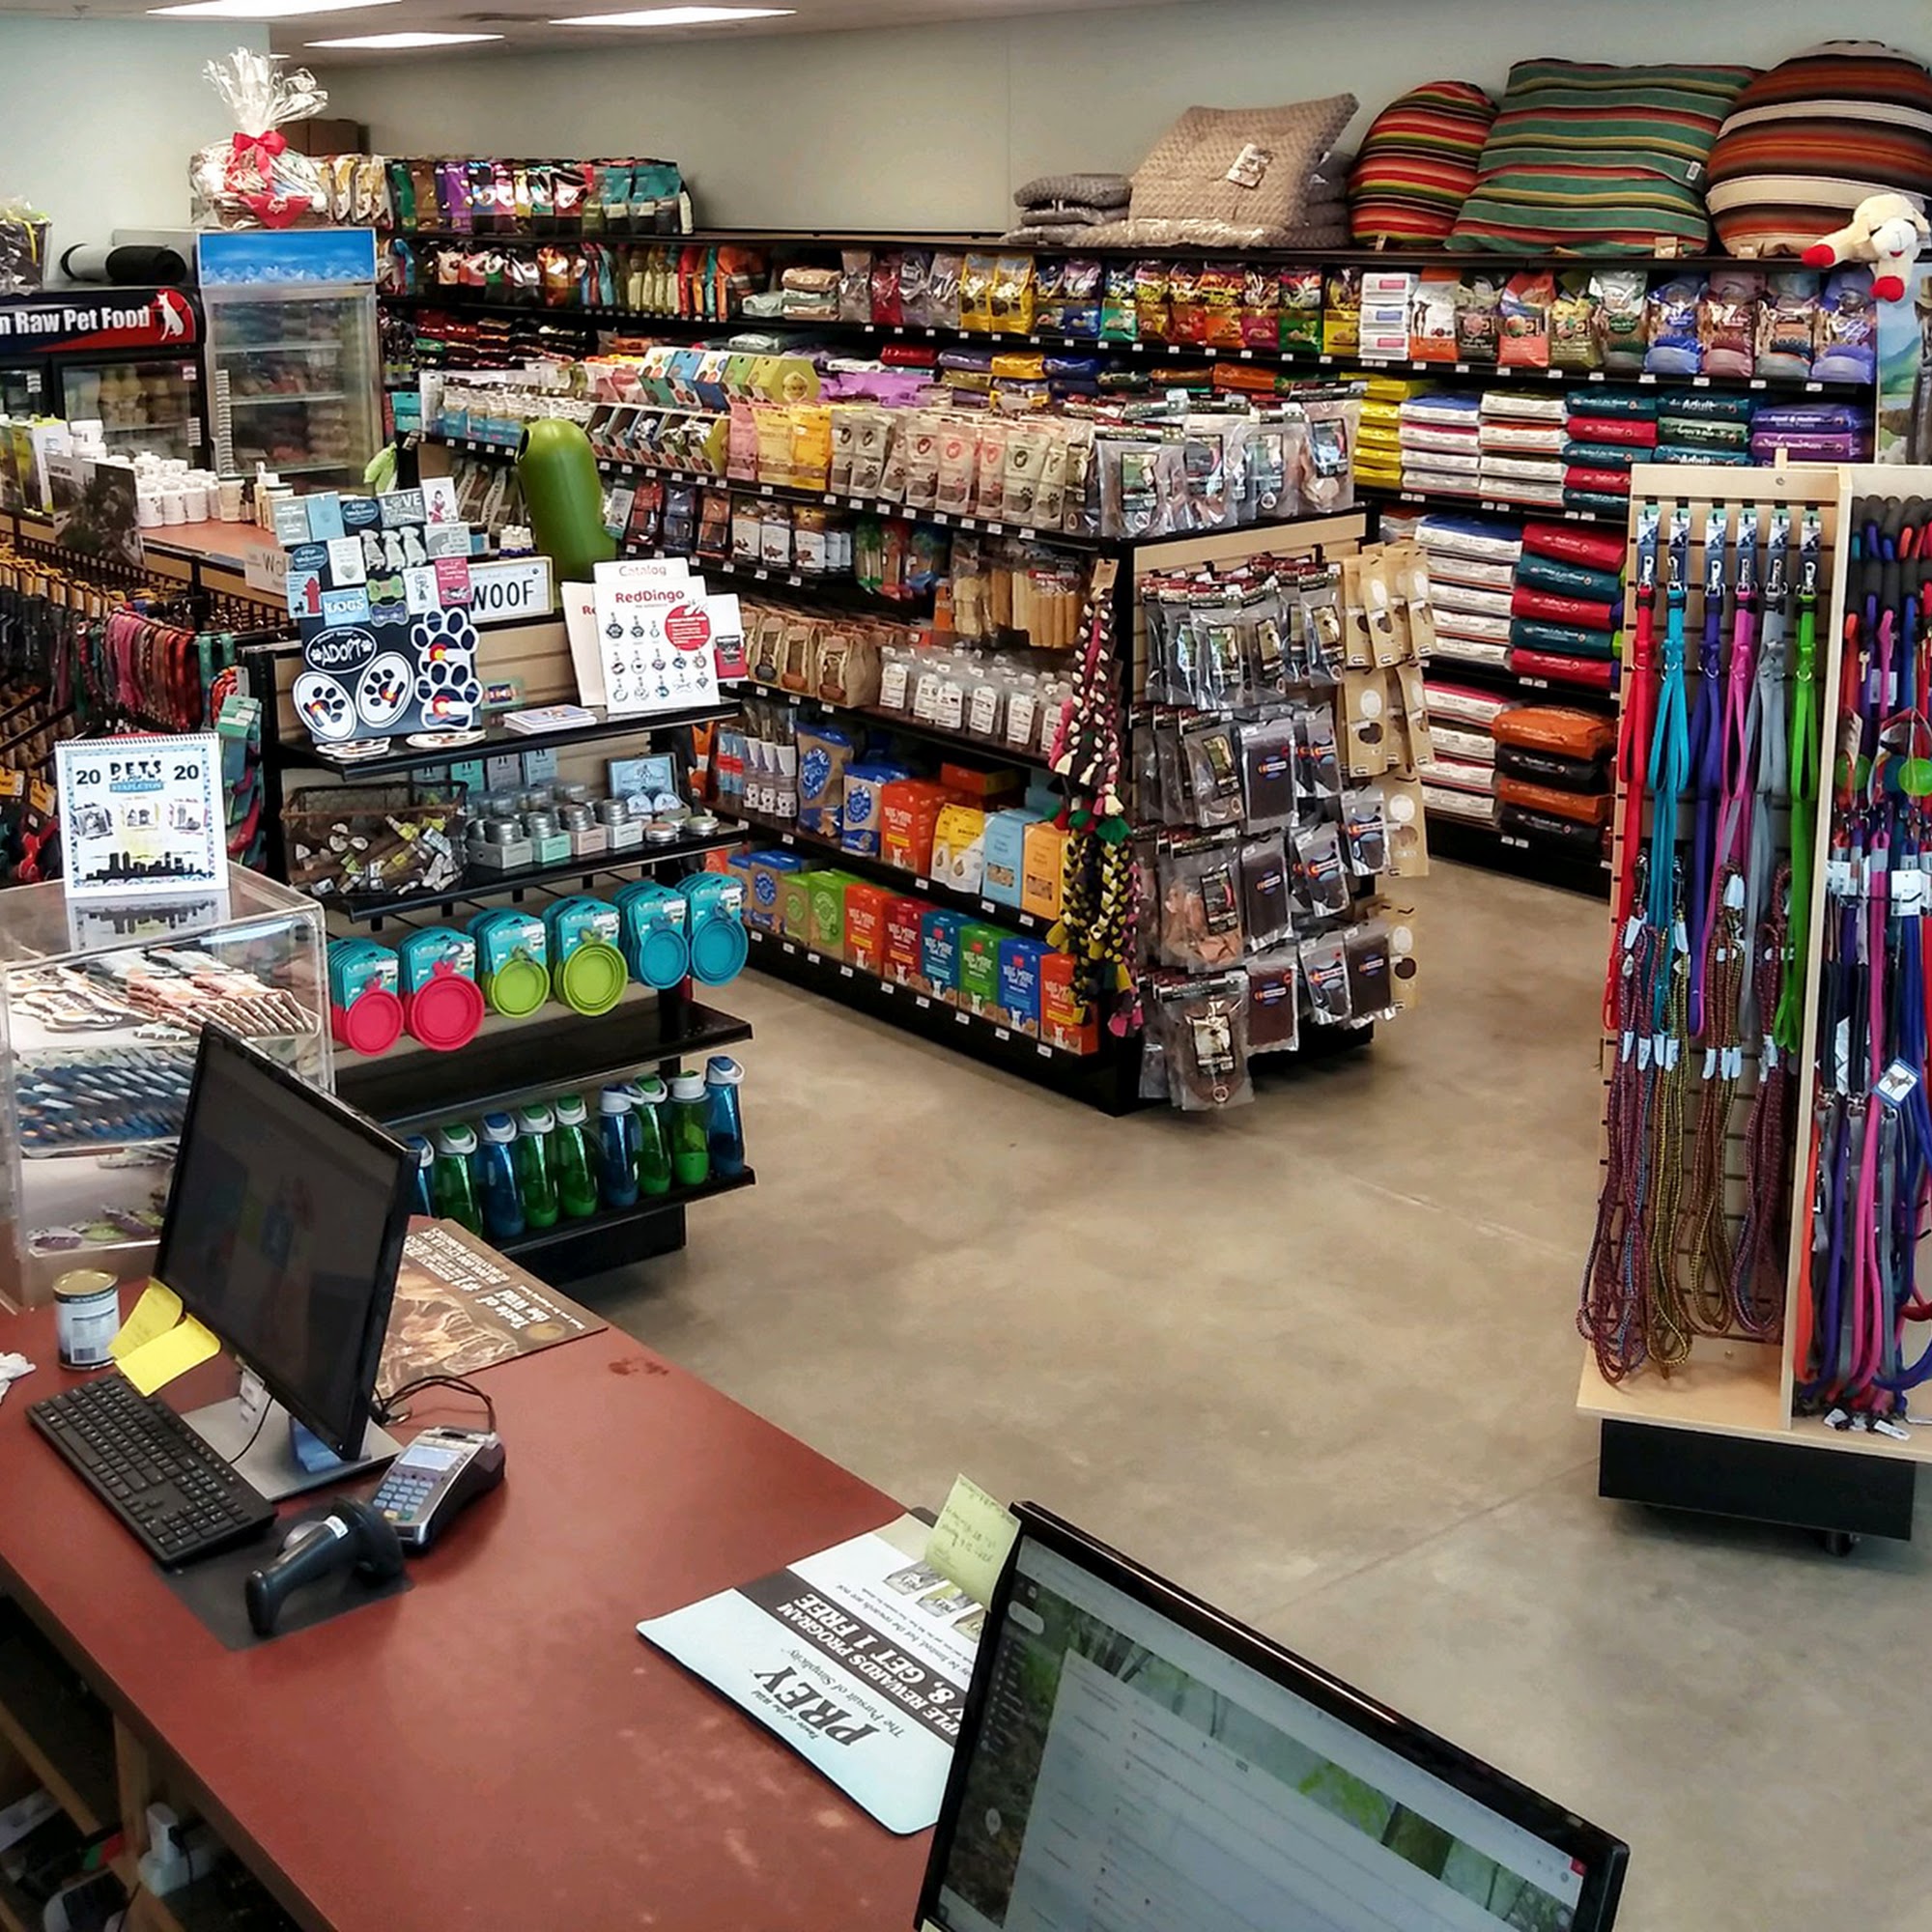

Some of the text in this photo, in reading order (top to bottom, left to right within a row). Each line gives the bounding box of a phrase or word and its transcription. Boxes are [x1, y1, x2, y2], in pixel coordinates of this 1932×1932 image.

[14, 311, 60, 334] Raw
[63, 308, 98, 331] Pet
[100, 305, 151, 329] Food
[618, 564, 667, 578] Catalog
[470, 580, 535, 611] WOOF
[615, 589, 685, 604] RedDingo
[321, 638, 362, 667] ADOPT
[76, 769, 101, 785] 20
[109, 759, 162, 776] PETS
[173, 764, 199, 781] 20
[475, 1295, 530, 1329] Taste of
[495, 1290, 551, 1322] the Wild
[777, 1603, 852, 1660] PROGRAM
[794, 1594, 955, 1705] 8, GET 1 FREE
[789, 1649, 905, 1738] The Pursuit of Simplicity
[848, 1653, 926, 1711] REWARDS
[753, 1665, 880, 1747] PREY
[922, 1706, 961, 1737] PLE
